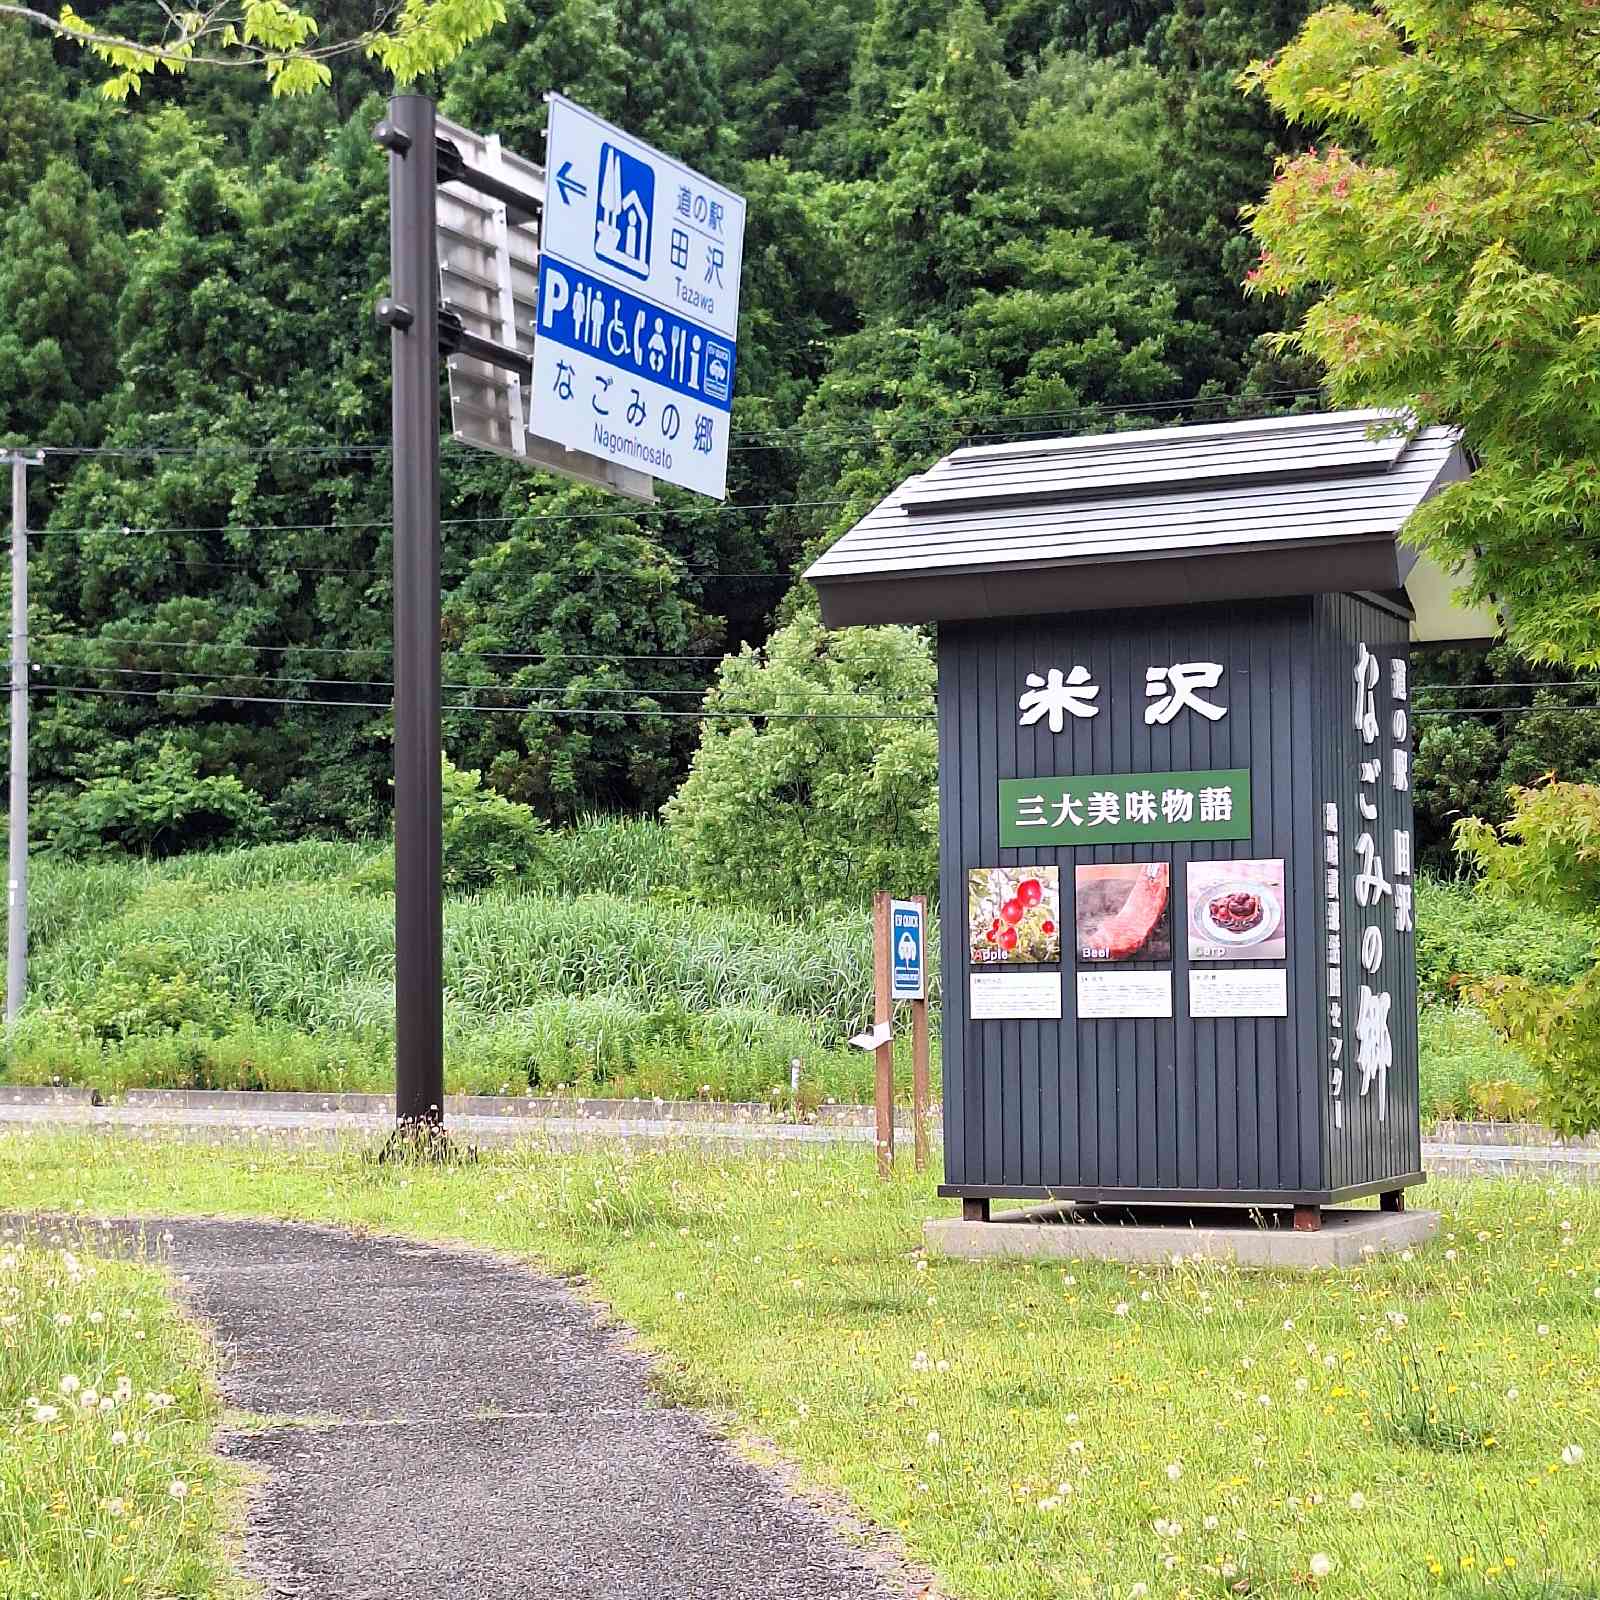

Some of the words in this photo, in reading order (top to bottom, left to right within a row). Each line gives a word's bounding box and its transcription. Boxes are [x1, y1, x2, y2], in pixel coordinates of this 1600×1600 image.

[677, 185, 724, 234] 道の駅
[670, 228, 724, 289] 田沢
[543, 268, 569, 328] P
[674, 276, 714, 314] Tazawa
[553, 359, 714, 455] なごみの郷
[594, 423, 672, 470] Nagominosato
[1018, 662, 1229, 733] 米沢
[1391, 659, 1409, 792] 道の駅
[1015, 786, 1233, 828] 三大美味物語
[1354, 642, 1393, 1122] なごみの郷
[1394, 829, 1413, 932] 田沢
[973, 949, 1009, 962] Apple
[1082, 947, 1110, 959] Beef
